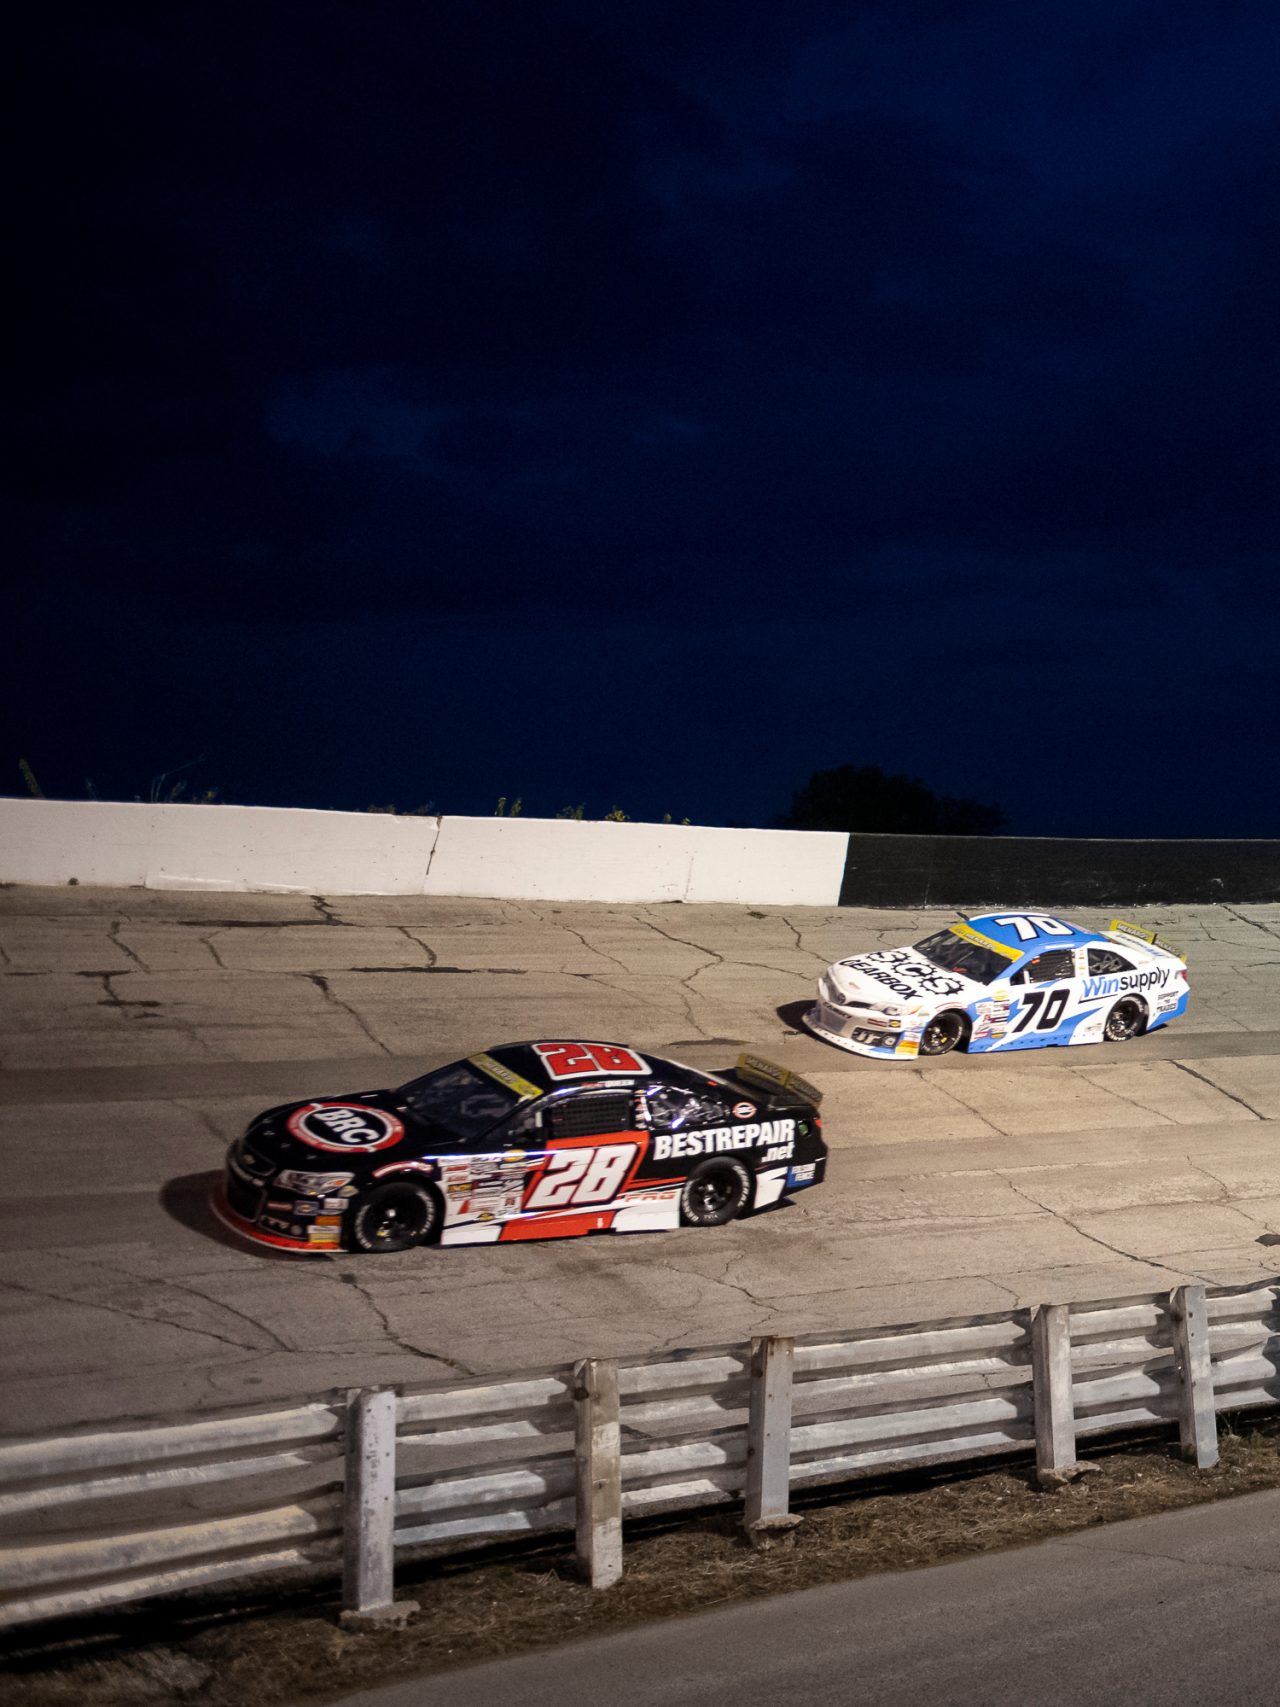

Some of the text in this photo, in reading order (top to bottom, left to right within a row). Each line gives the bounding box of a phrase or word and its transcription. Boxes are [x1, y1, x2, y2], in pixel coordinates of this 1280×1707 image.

[995, 916, 1075, 941] 70
[839, 959, 924, 1000] GEARBOX
[1082, 967, 1170, 998] Winsupply
[1012, 989, 1070, 1033] 70
[533, 1043, 651, 1079] 28
[314, 1109, 380, 1143] BRC
[653, 1119, 796, 1161] BESTREPAIR
[761, 1142, 796, 1163] .net
[524, 1143, 639, 1208] 28
